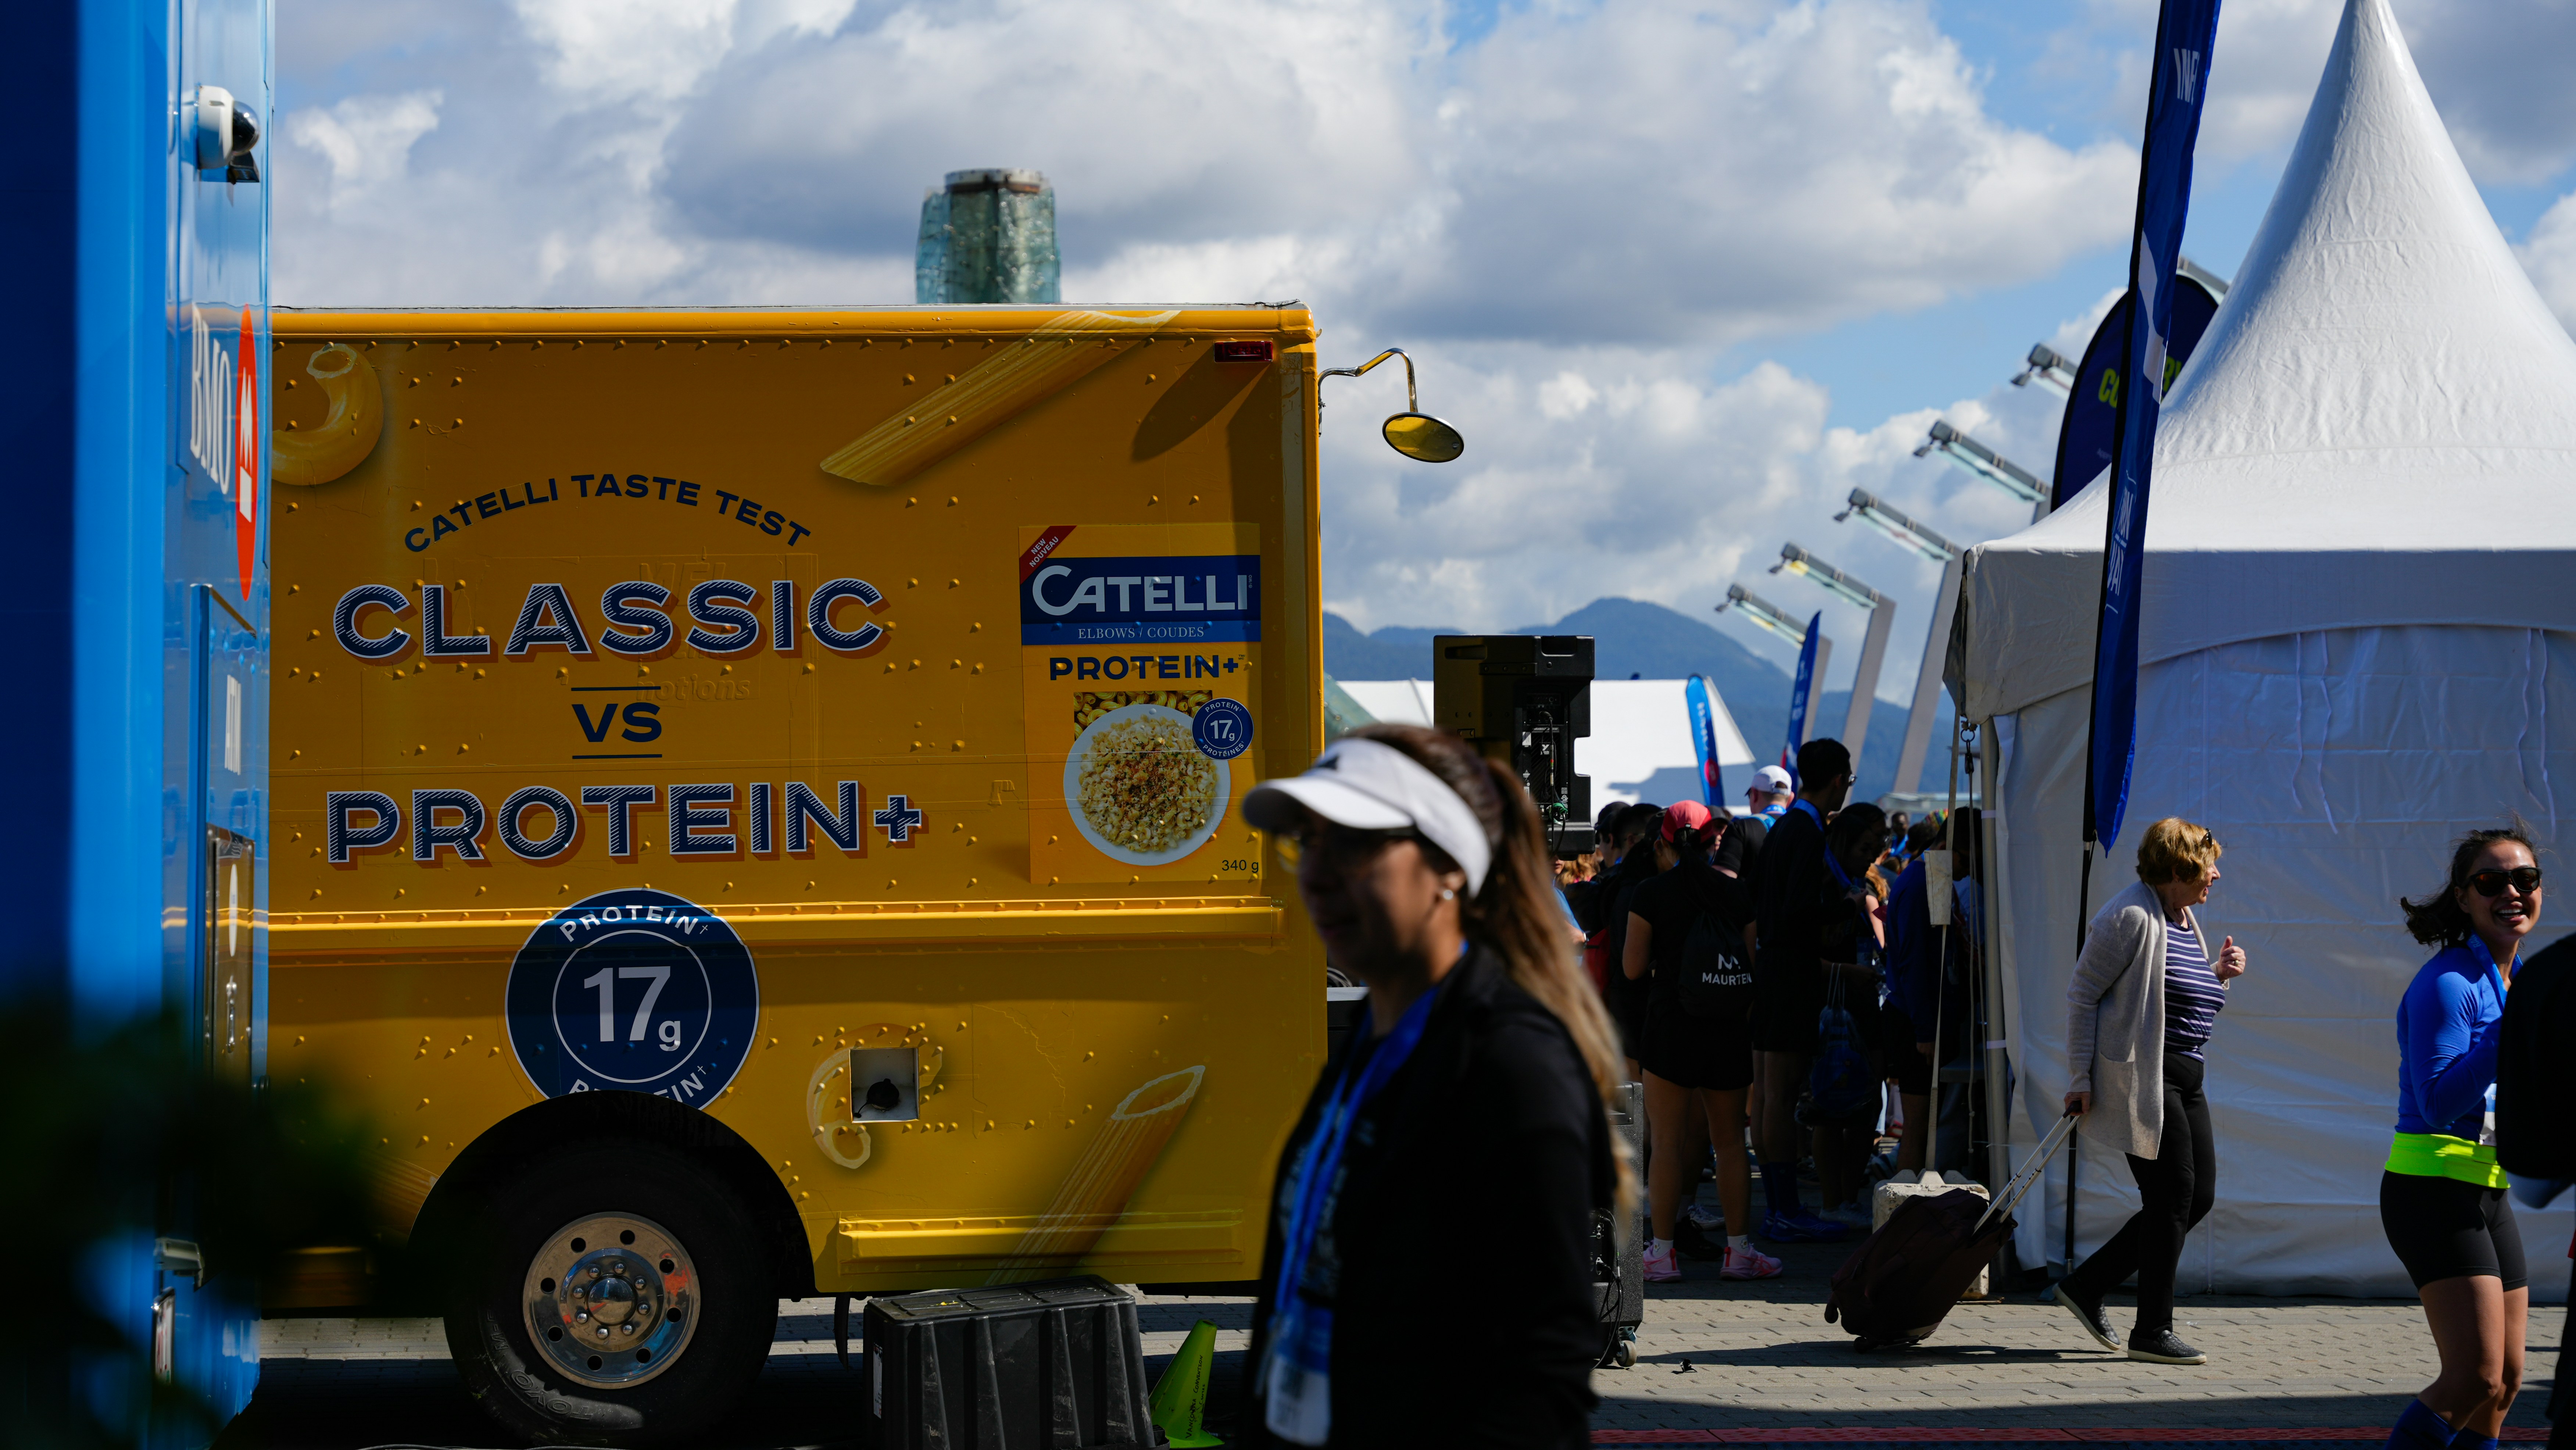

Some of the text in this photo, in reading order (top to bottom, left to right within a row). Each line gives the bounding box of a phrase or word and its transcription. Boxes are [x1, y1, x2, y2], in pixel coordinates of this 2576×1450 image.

[190, 301, 231, 494] BMO
[404, 474, 811, 552] CATELLI TASTE TEST
[1029, 536, 1059, 568] NOUVEAU
[1030, 538, 1046, 555] NEW
[1032, 565, 1248, 616] CATELLI
[333, 578, 884, 659] CLASSIC
[1078, 628, 1135, 639] ELBOWS
[1147, 626, 1205, 638] COUDES
[1049, 654, 1239, 681] PROTEIN+
[571, 702, 663, 743] VS
[1210, 719, 1235, 742] 17g
[326, 780, 922, 864] PROTEIN+
[1222, 860, 1259, 873] 340 g
[1702, 972, 1752, 986] MAURTEN
[584, 965, 681, 1052] 17g
[510, 1370, 593, 1422] TOYO
[1185, 1354, 1203, 1439] VANCOUVER CONVENTION
